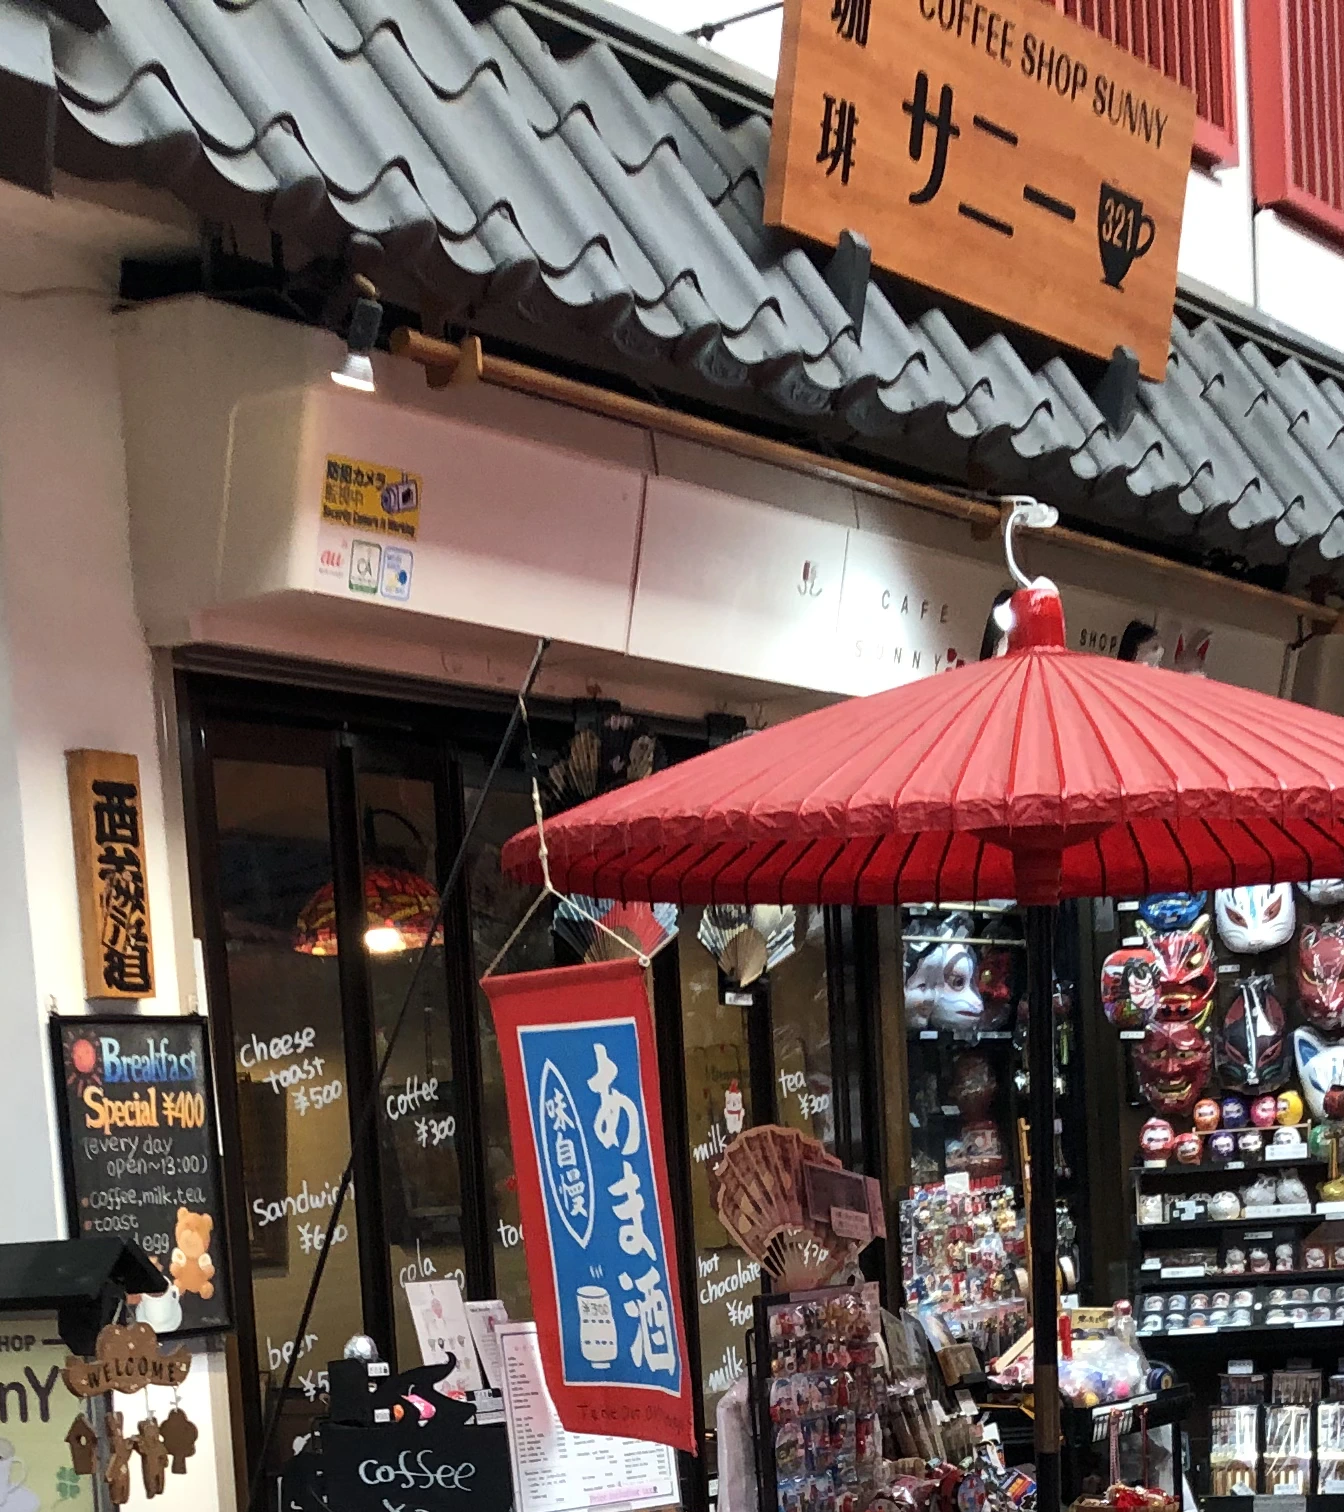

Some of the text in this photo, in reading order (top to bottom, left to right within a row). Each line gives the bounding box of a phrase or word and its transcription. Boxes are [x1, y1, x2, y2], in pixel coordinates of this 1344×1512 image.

[1021, 33, 1088, 101] SHOP
[1093, 74, 1169, 149] SUNNY
[902, 69, 1076, 238] サニー
[1103, 197, 1135, 252] 321
[880, 589, 949, 625] CAFE
[1079, 628, 1118, 655] SHOP
[101, 1037, 196, 1083] Breakfast
[263, 1057, 325, 1094] toast
[292, 1081, 343, 1116] ¥500
[779, 1069, 806, 1098] tea
[83, 1086, 204, 1135] Special ¥400
[143, 1136, 173, 1156] day
[414, 1116, 455, 1148] ¥300
[693, 1123, 727, 1164] milk
[545, 1088, 588, 1218] 味自慢
[94, 1213, 139, 1231] toast
[584, 1044, 676, 1375] あま酒
[142, 1233, 169, 1254] egg
[698, 1253, 719, 1278] hot
[700, 1259, 761, 1304] chocolate
[87, 1356, 175, 1389] WELCOME
[709, 1346, 743, 1392] milk
[359, 1450, 477, 1491] coffee
